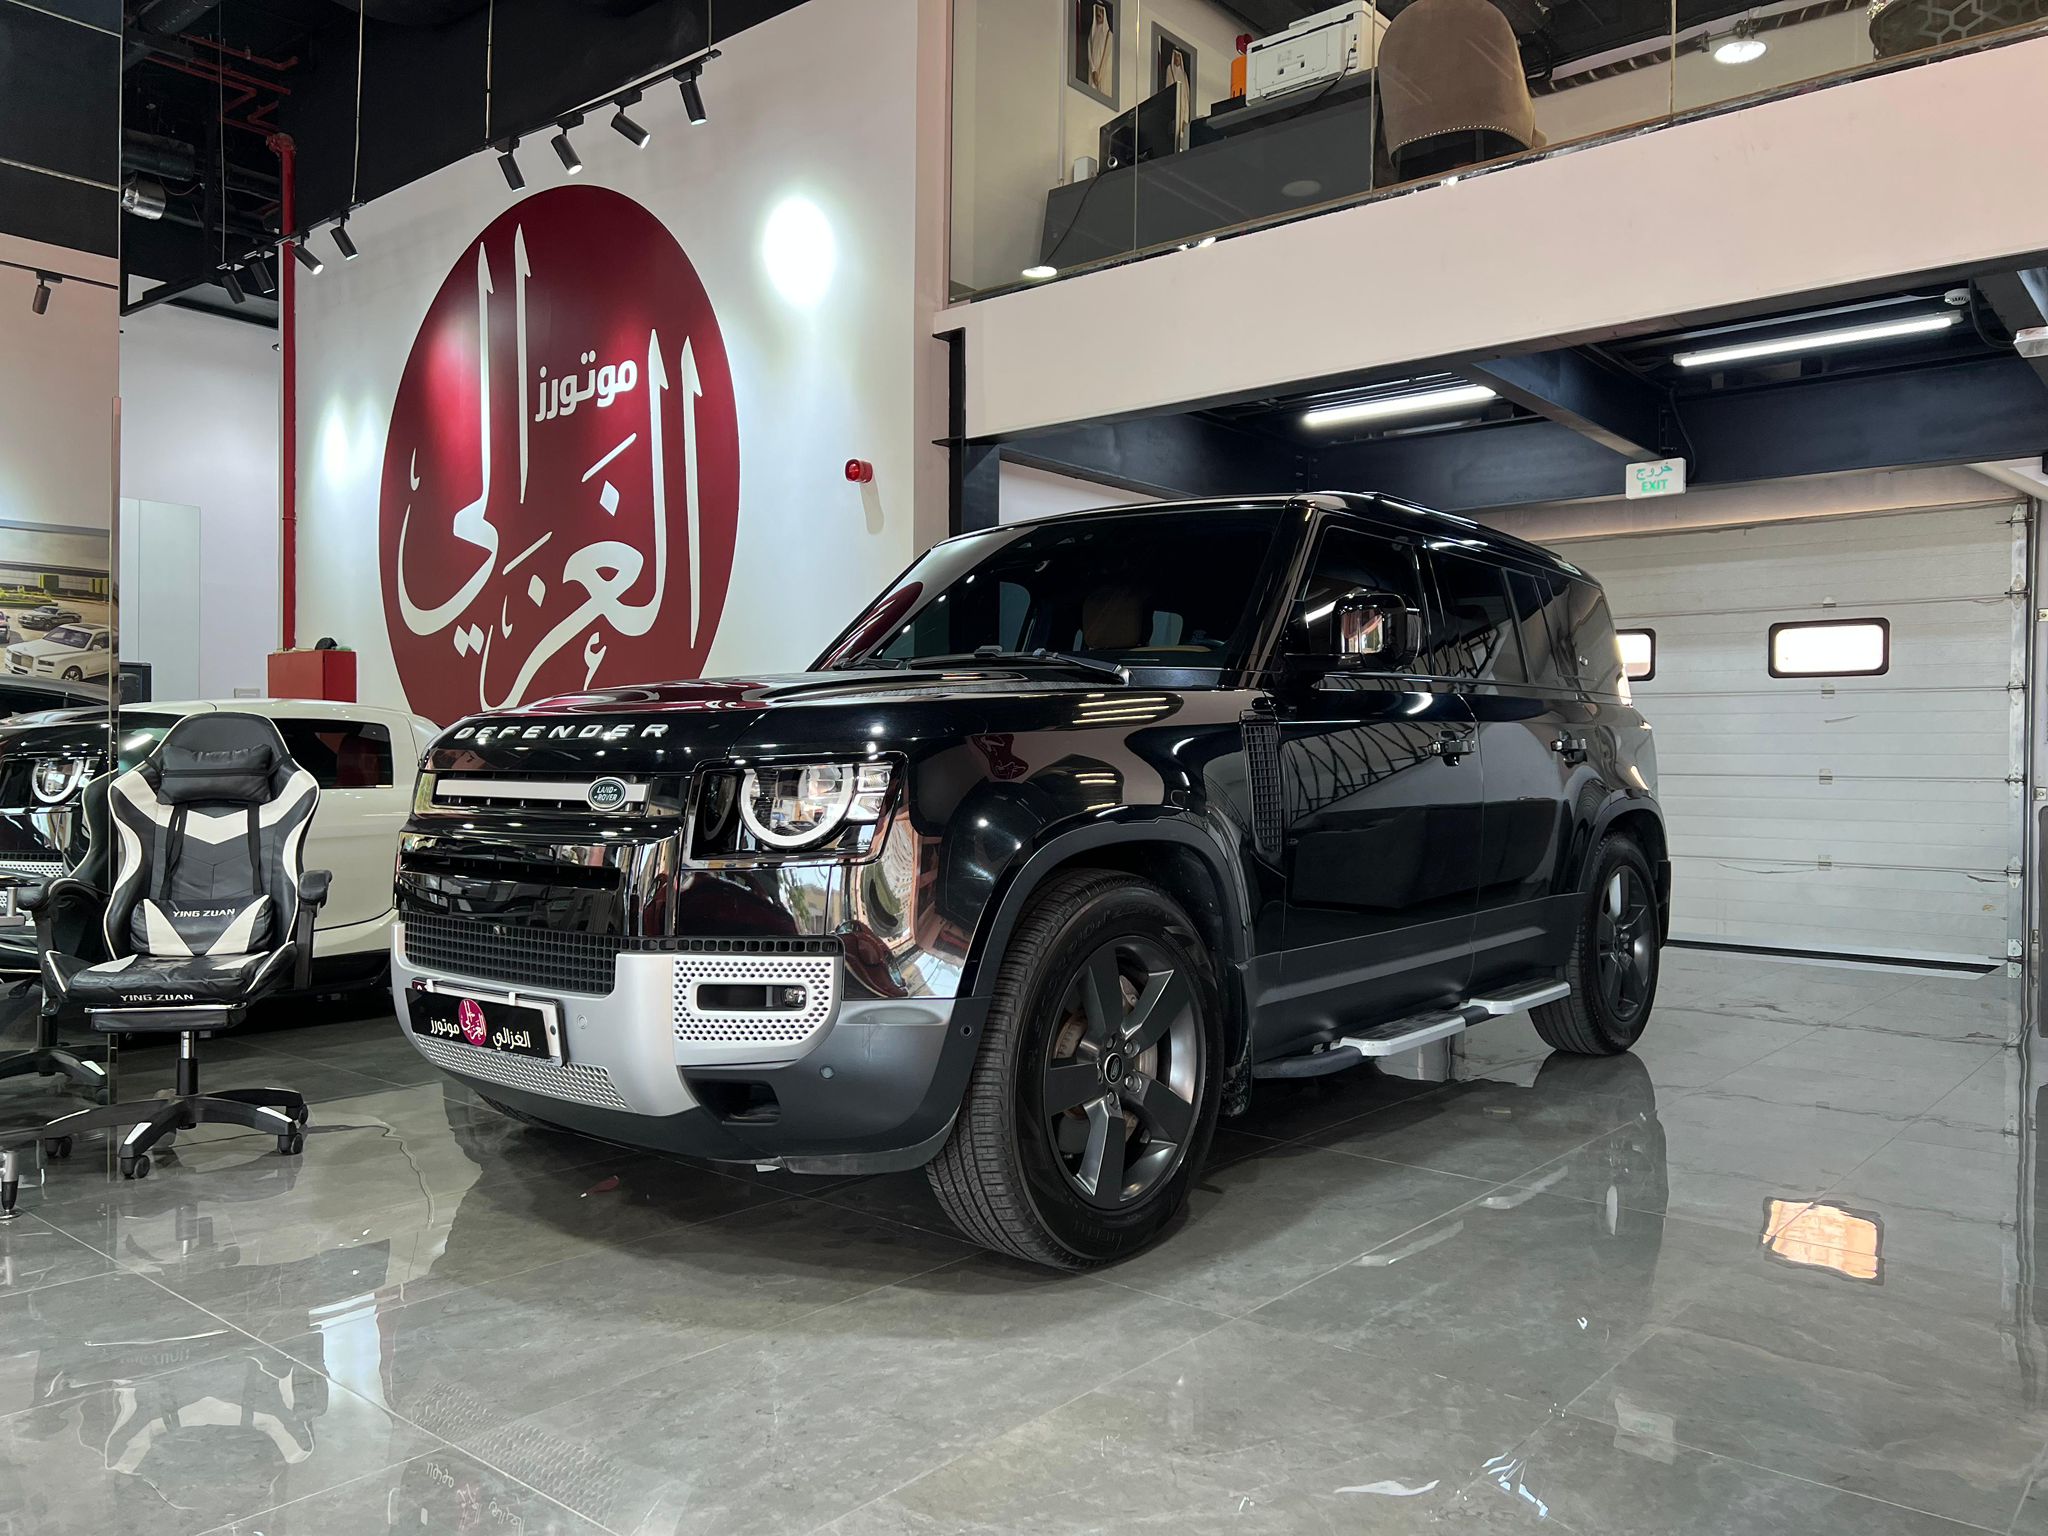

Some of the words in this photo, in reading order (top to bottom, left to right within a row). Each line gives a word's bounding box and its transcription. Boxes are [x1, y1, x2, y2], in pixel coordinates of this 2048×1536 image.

[534, 350, 638, 422] موتورز
[1635, 461, 1673, 481] خروج
[1641, 478, 1668, 493] EXIT
[453, 723, 669, 740] DEFENDER
[596, 785, 614, 794] LAND
[596, 793, 618, 801] ROVER
[172, 910, 201, 918] YING
[203, 908, 236, 918] ZUAN
[120, 994, 153, 1002] YING
[430, 1016, 460, 1038] موتورز
[492, 1026, 532, 1051] الغزالي
